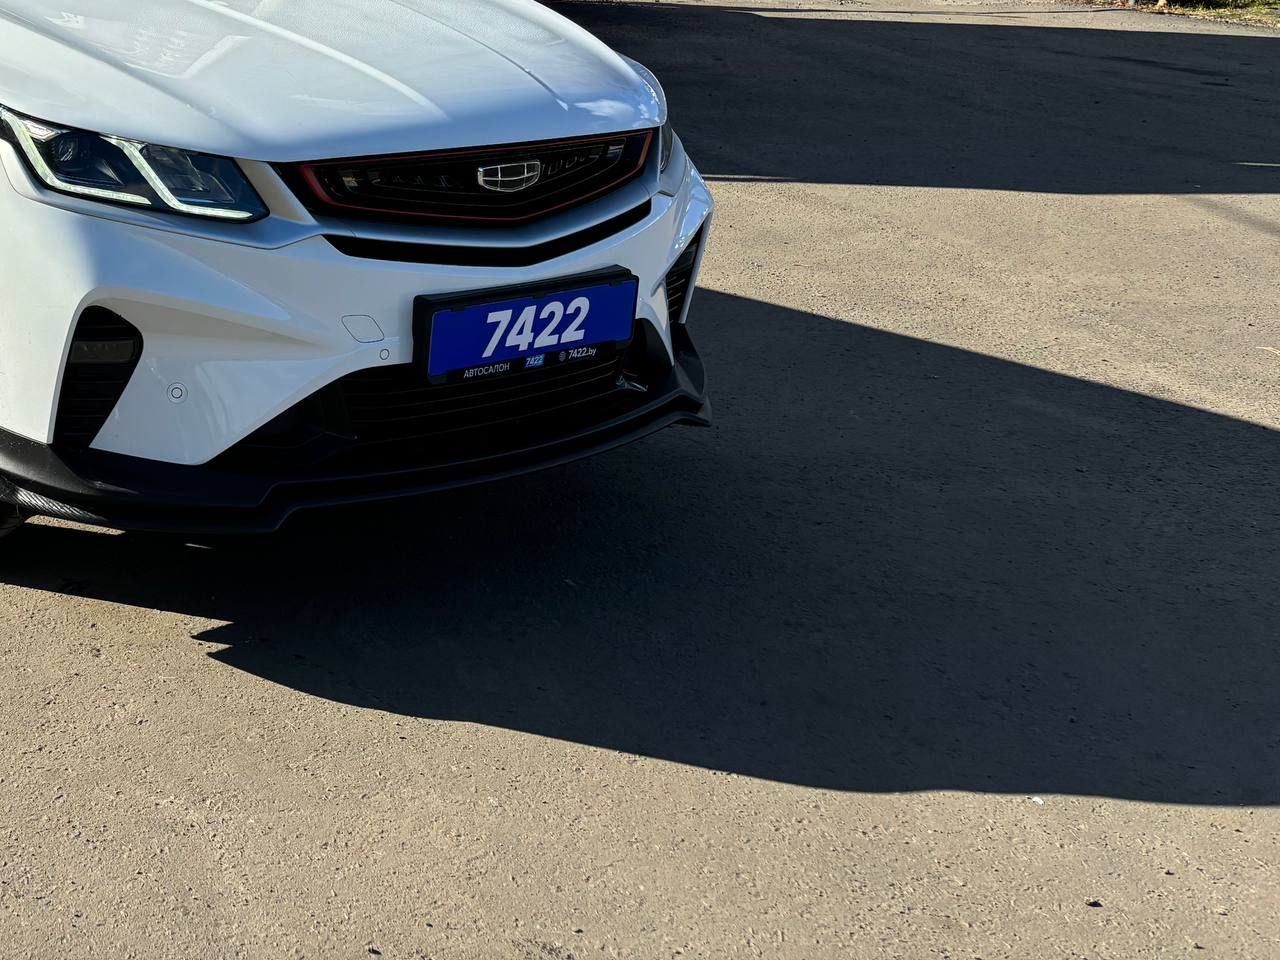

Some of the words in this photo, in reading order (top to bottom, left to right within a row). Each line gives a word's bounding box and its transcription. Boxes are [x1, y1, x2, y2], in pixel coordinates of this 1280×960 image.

[482, 296, 590, 358] 7422
[526, 355, 543, 365] 7422
[568, 347, 596, 360] 7422.by
[464, 363, 510, 378] АВТОСАЛОН
